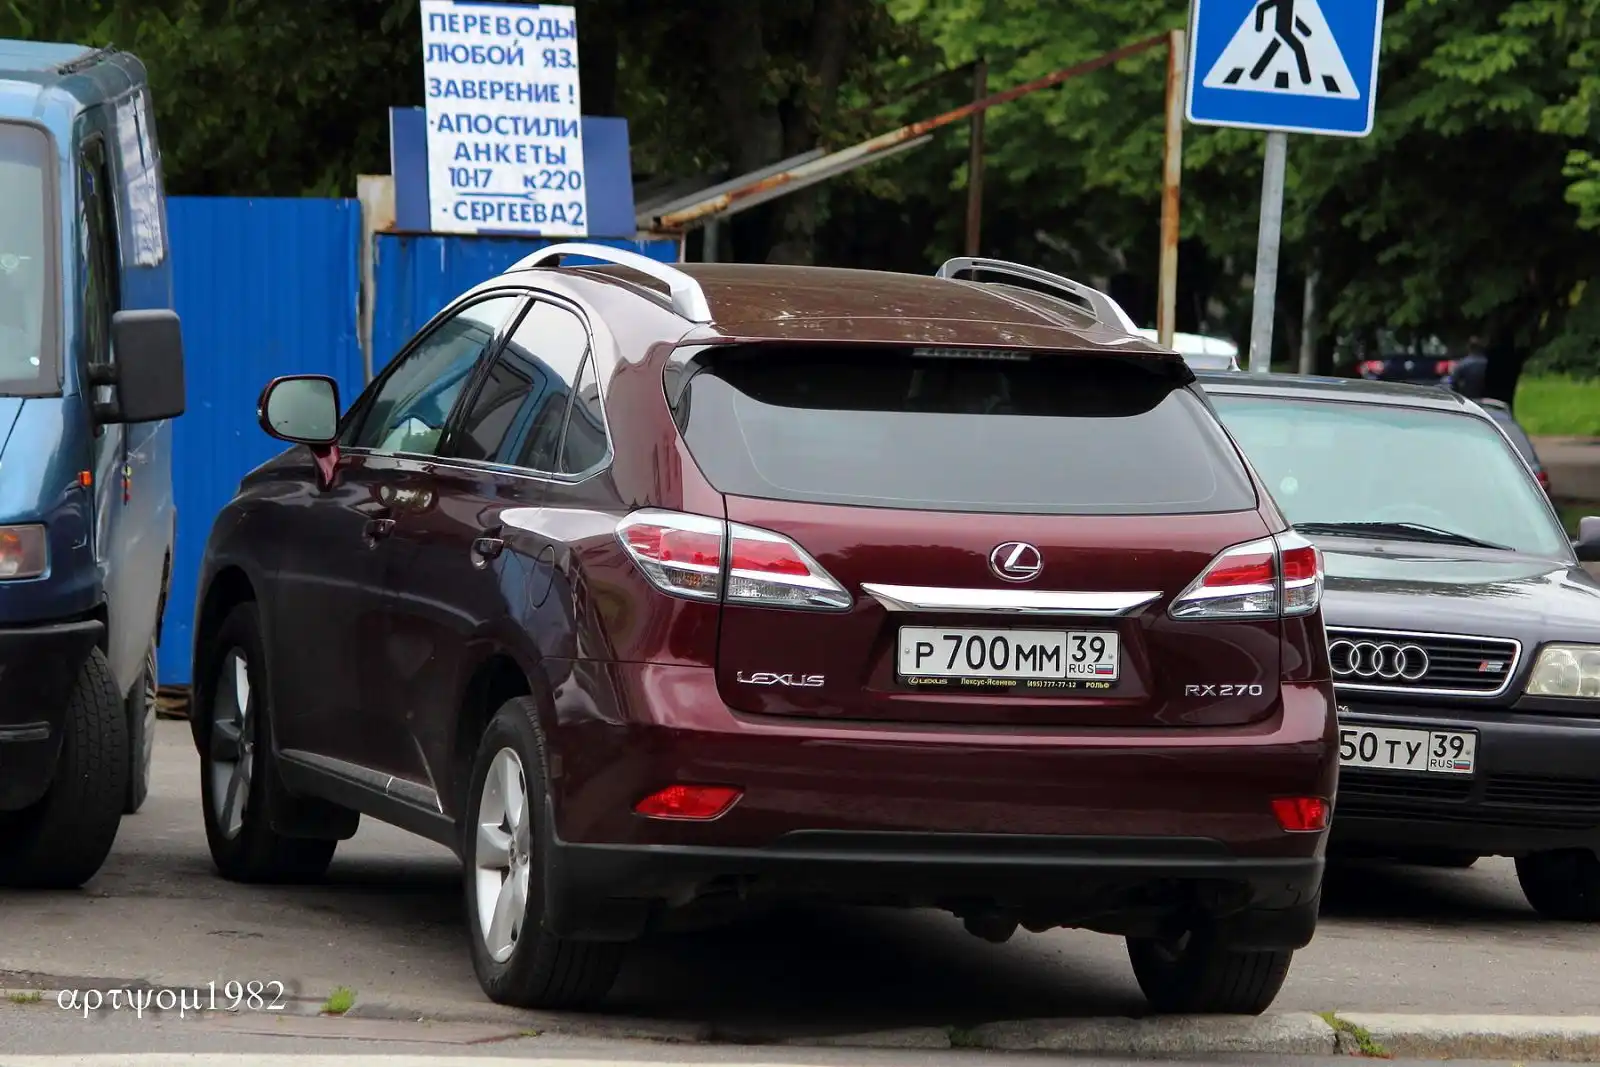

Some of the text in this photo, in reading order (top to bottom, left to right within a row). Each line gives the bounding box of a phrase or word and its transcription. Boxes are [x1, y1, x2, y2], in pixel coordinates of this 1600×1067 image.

[429, 13, 575, 41] ПЕРЕВОДЫ
[426, 40, 576, 68] ЛЮБОЙ ЯЗ.
[429, 78, 560, 104] ЗАВЕРЕНИЕ
[454, 142, 566, 165] АНКЕТЫ
[1071, 636, 1106, 663] 39
[737, 671, 825, 686] LEXUS
[1068, 664, 1094, 673] RUS
[1185, 684, 1263, 697] RX 270
[1433, 734, 1465, 758] 39
[1430, 759, 1452, 768] RUS
